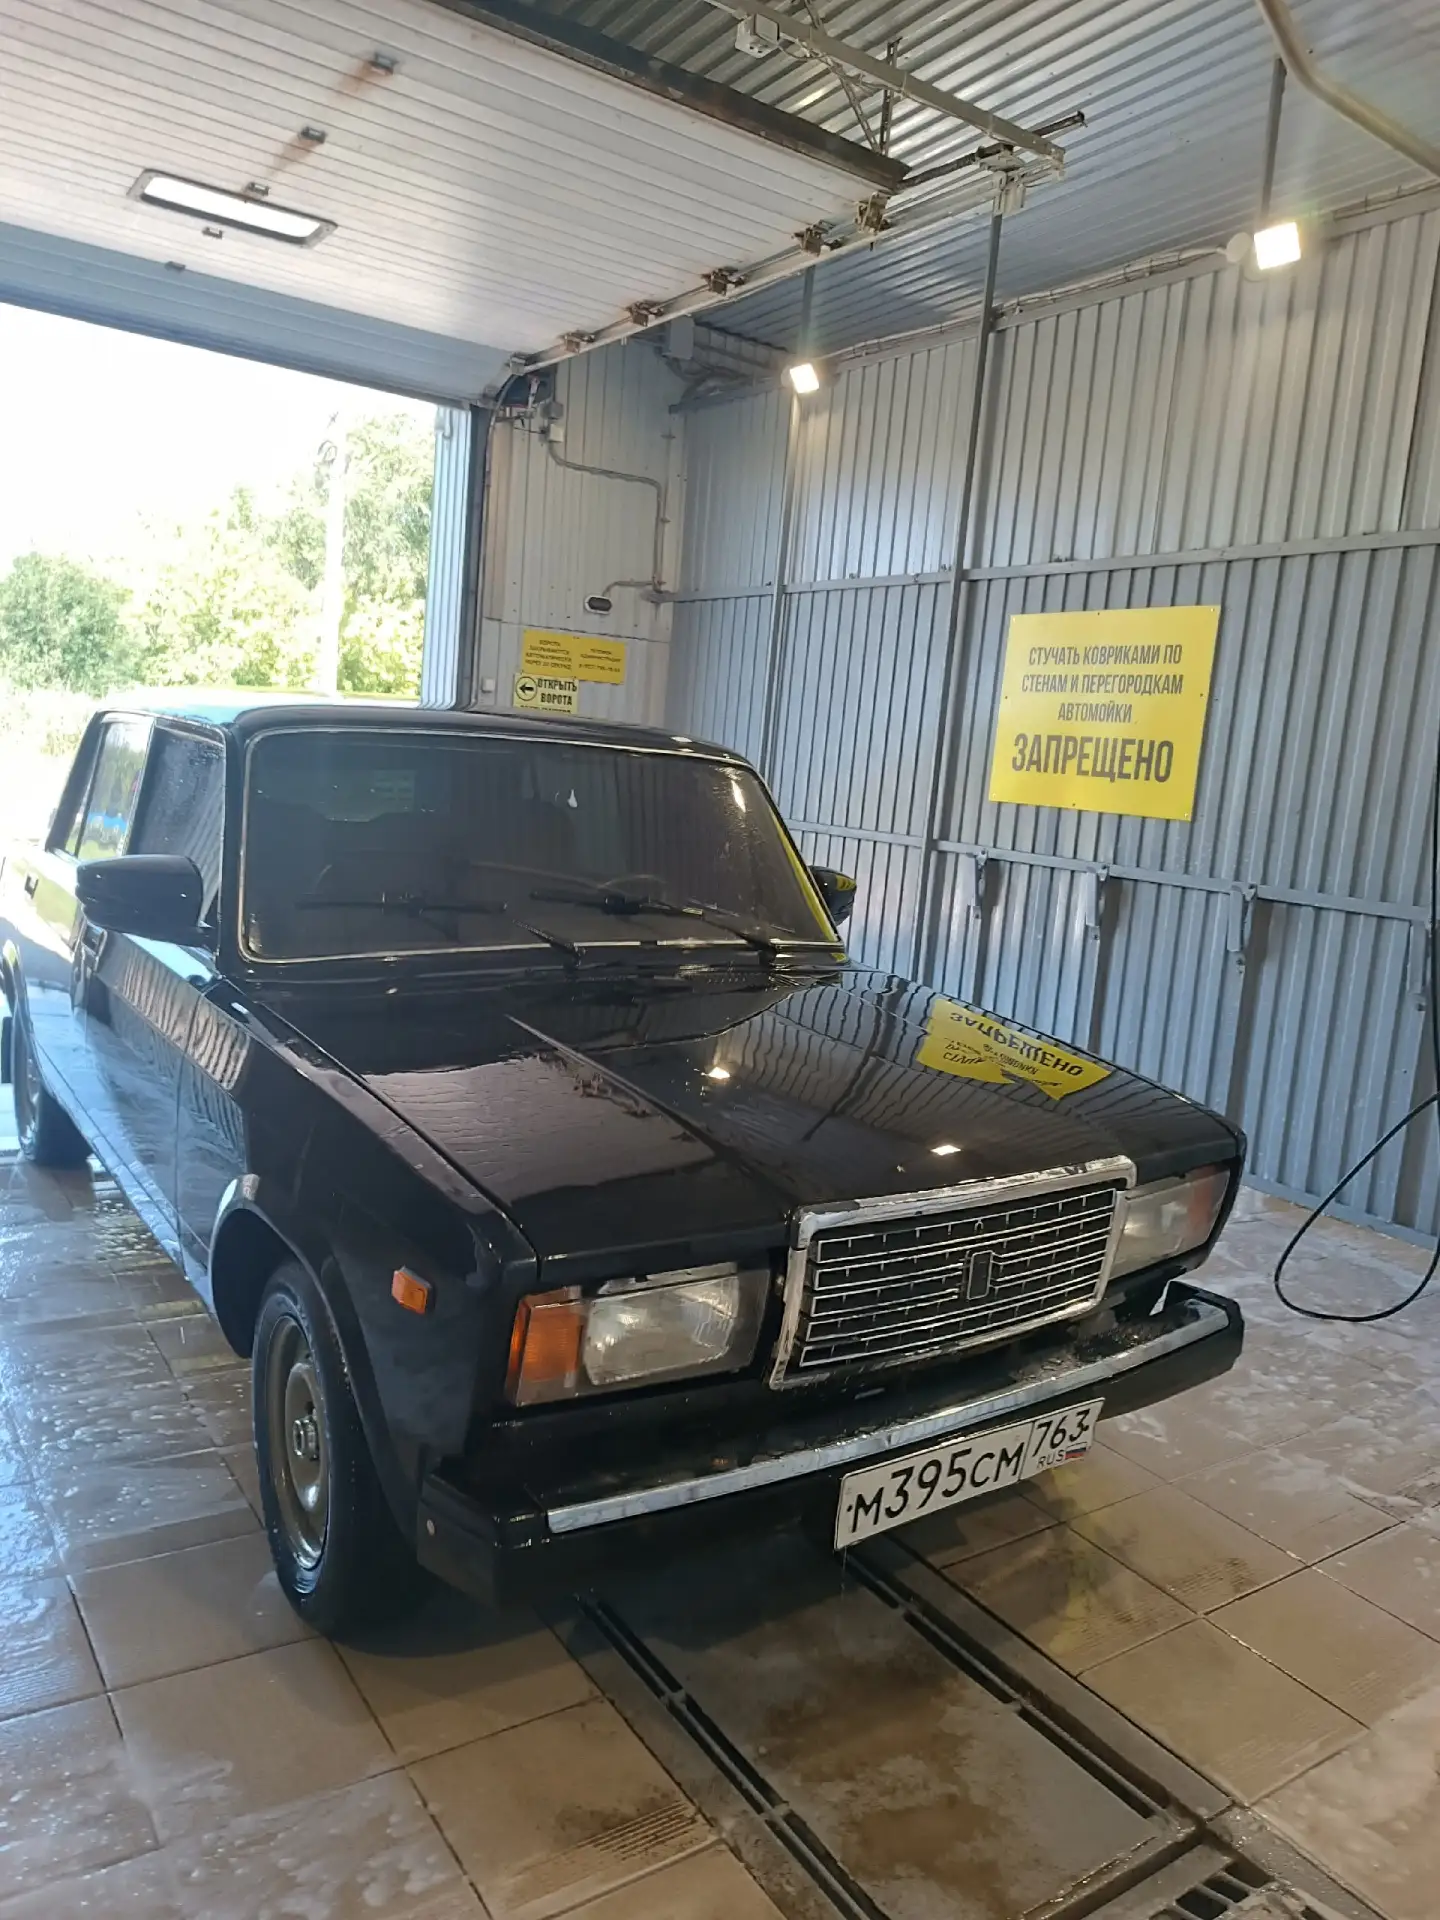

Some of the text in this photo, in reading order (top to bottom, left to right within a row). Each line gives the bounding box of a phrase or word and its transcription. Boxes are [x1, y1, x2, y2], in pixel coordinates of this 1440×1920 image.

[1028, 643, 1182, 665] СТУЧАТЬ КОВРИКАМИ ПО
[537, 678, 578, 692] ОТКРЫТЬ
[1021, 673, 1184, 695] СТЕНАМ И ПЕРЕГОРОДКАМ
[540, 693, 573, 706] ВОРОТА
[1057, 700, 1133, 724] АВТОМОЙКИ
[1011, 732, 1174, 783] ЗАПРЕЩЕНО
[1032, 1408, 1091, 1457] 763
[1037, 1449, 1065, 1468] RUS
